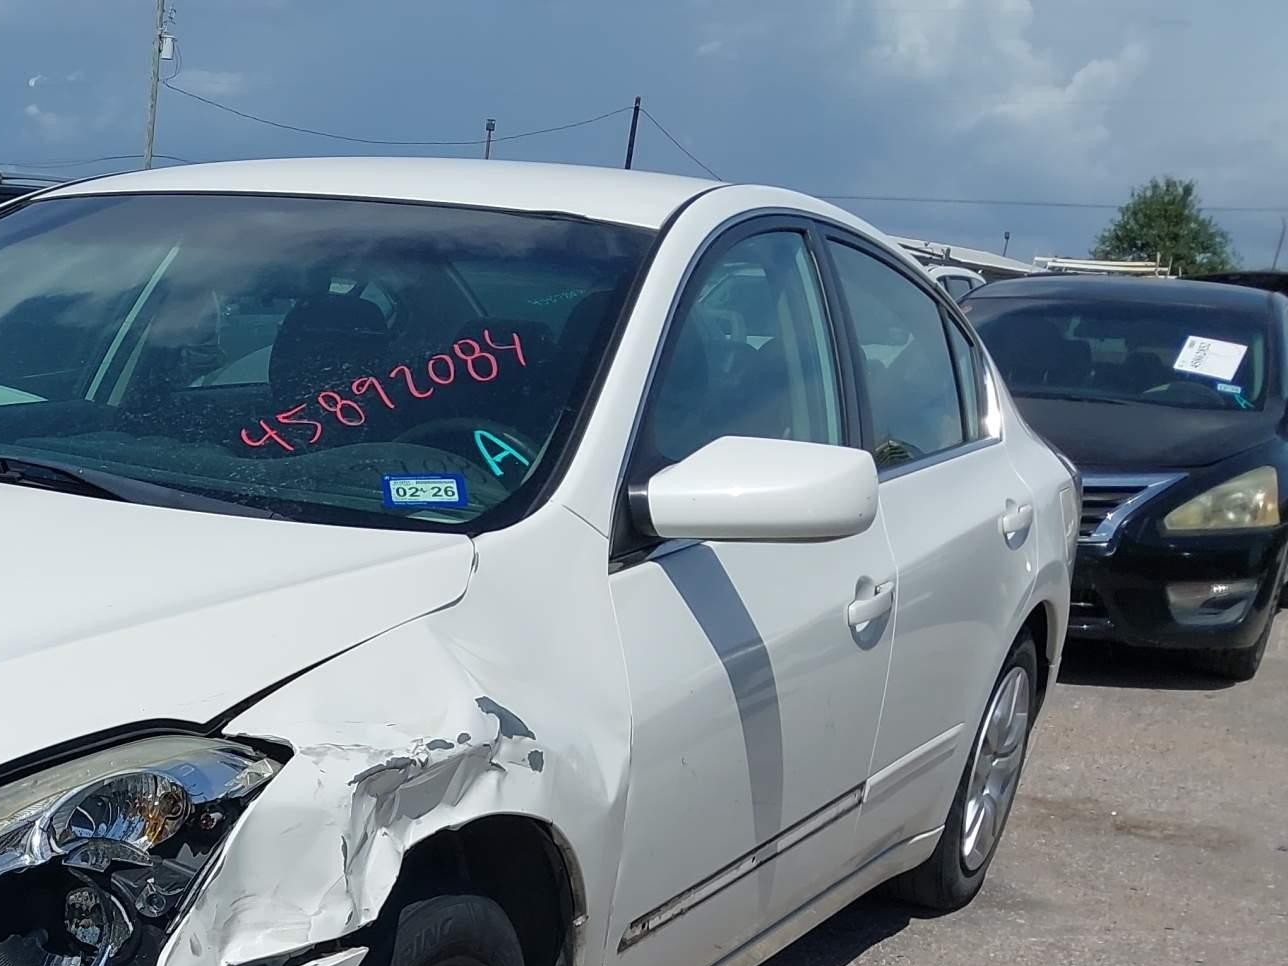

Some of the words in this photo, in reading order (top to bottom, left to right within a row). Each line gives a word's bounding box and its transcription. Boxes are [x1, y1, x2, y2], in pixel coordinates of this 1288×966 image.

[240, 329, 527, 451] 45892084
[473, 429, 530, 477] A
[395, 486, 420, 498] 02
[430, 485, 456, 498] 26
